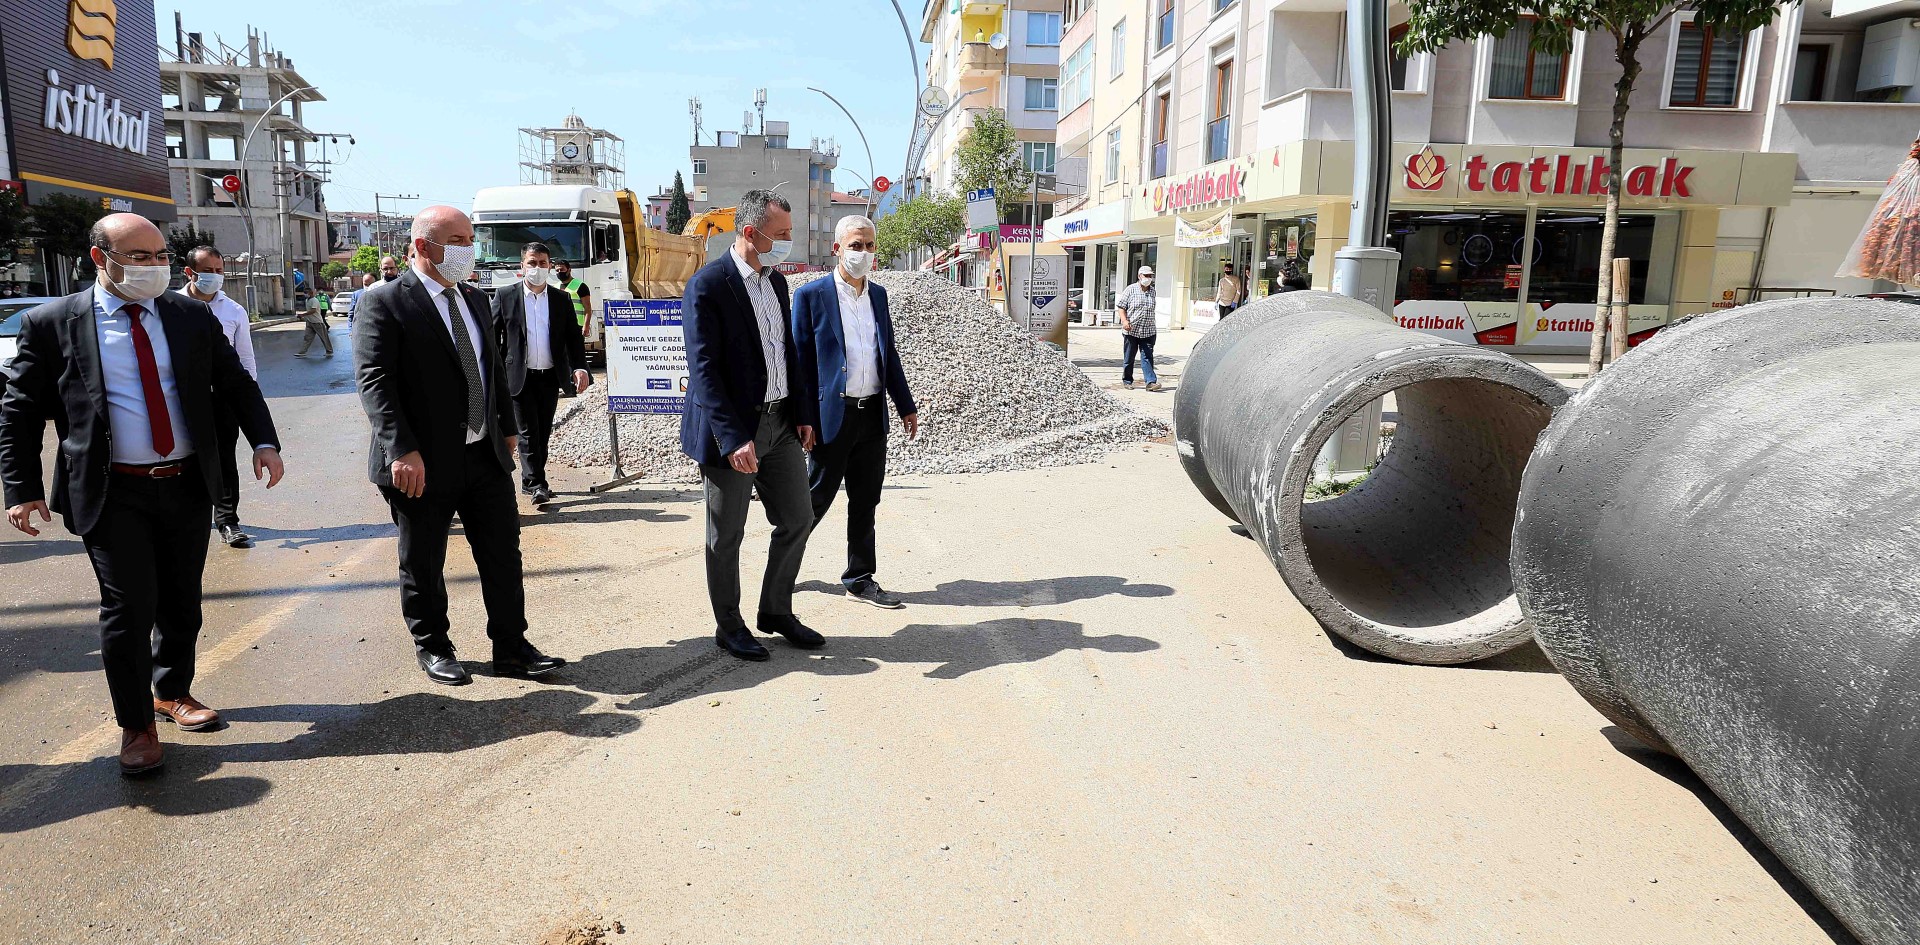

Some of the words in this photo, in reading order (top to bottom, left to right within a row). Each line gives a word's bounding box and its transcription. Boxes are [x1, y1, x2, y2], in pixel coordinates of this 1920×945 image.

[44, 69, 150, 156] istikbal
[1463, 154, 1695, 198] tatlıbak
[968, 191, 977, 201] D
[1399, 316, 1465, 330] tatlıbak
